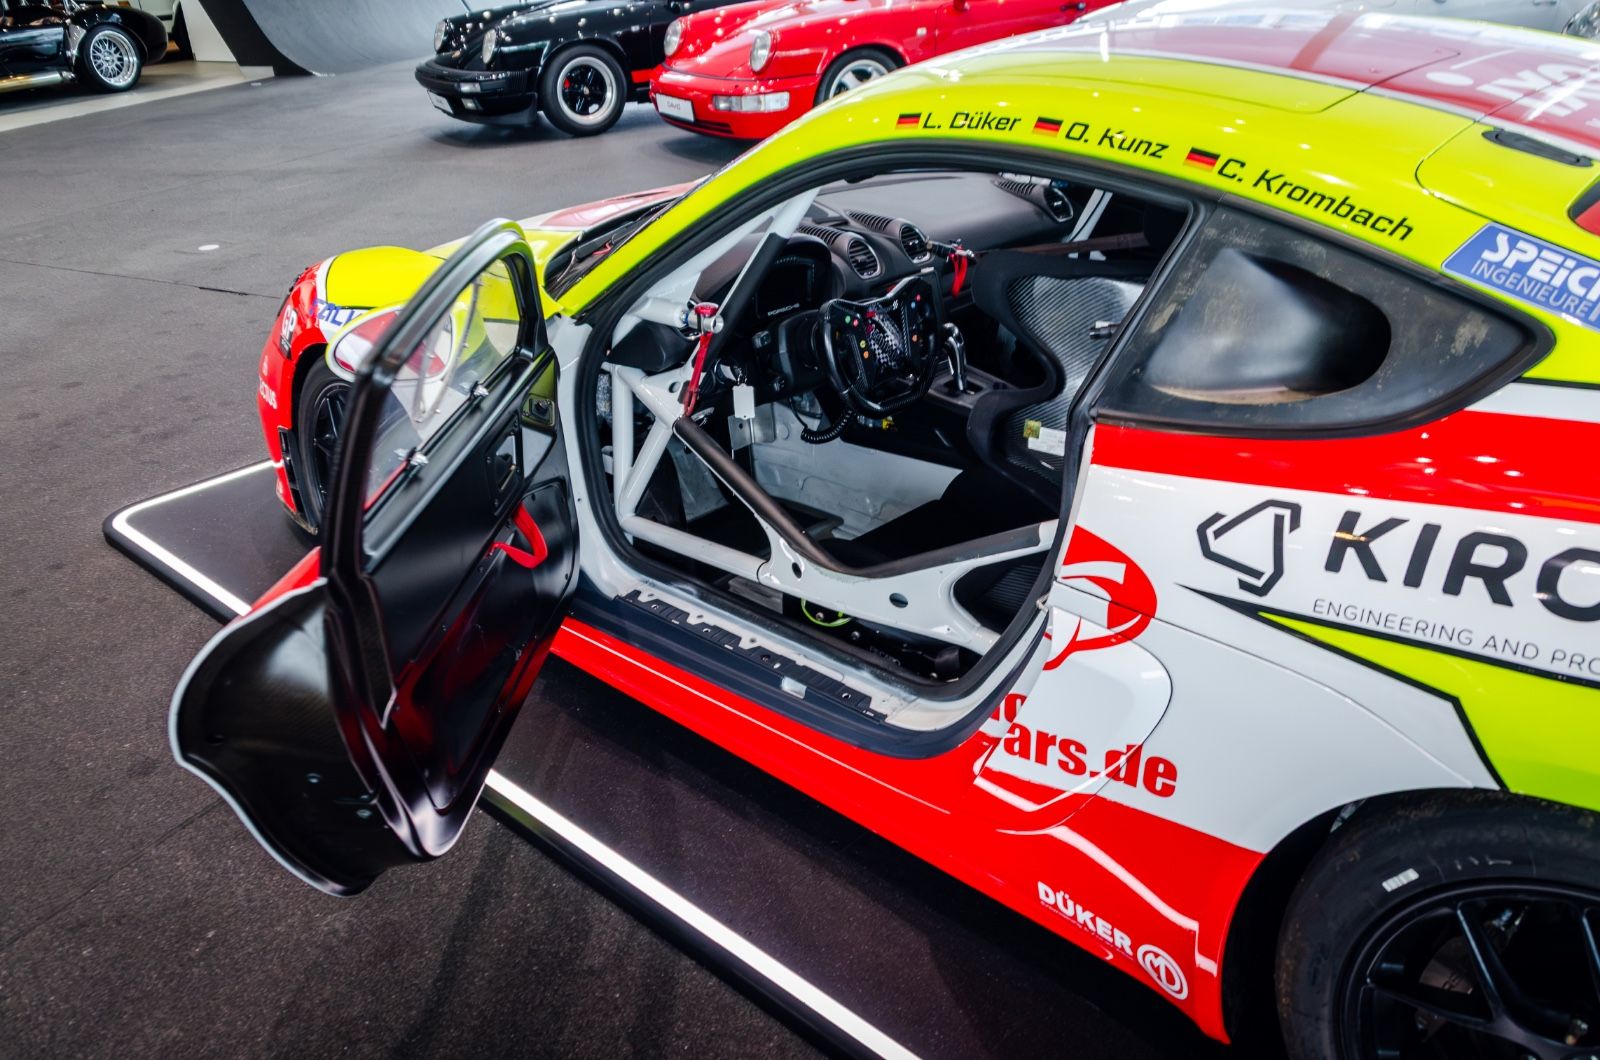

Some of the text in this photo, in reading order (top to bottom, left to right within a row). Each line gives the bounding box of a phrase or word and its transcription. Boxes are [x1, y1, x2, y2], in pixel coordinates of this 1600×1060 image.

[922, 111, 1022, 131] L. Düker
[1098, 128, 1169, 159] Kunz
[1217, 158, 1414, 241] C. Krombach
[1312, 598, 1473, 646] ENGINEERING
[1482, 635, 1539, 660] AND
[1037, 880, 1134, 956] DÜKER
